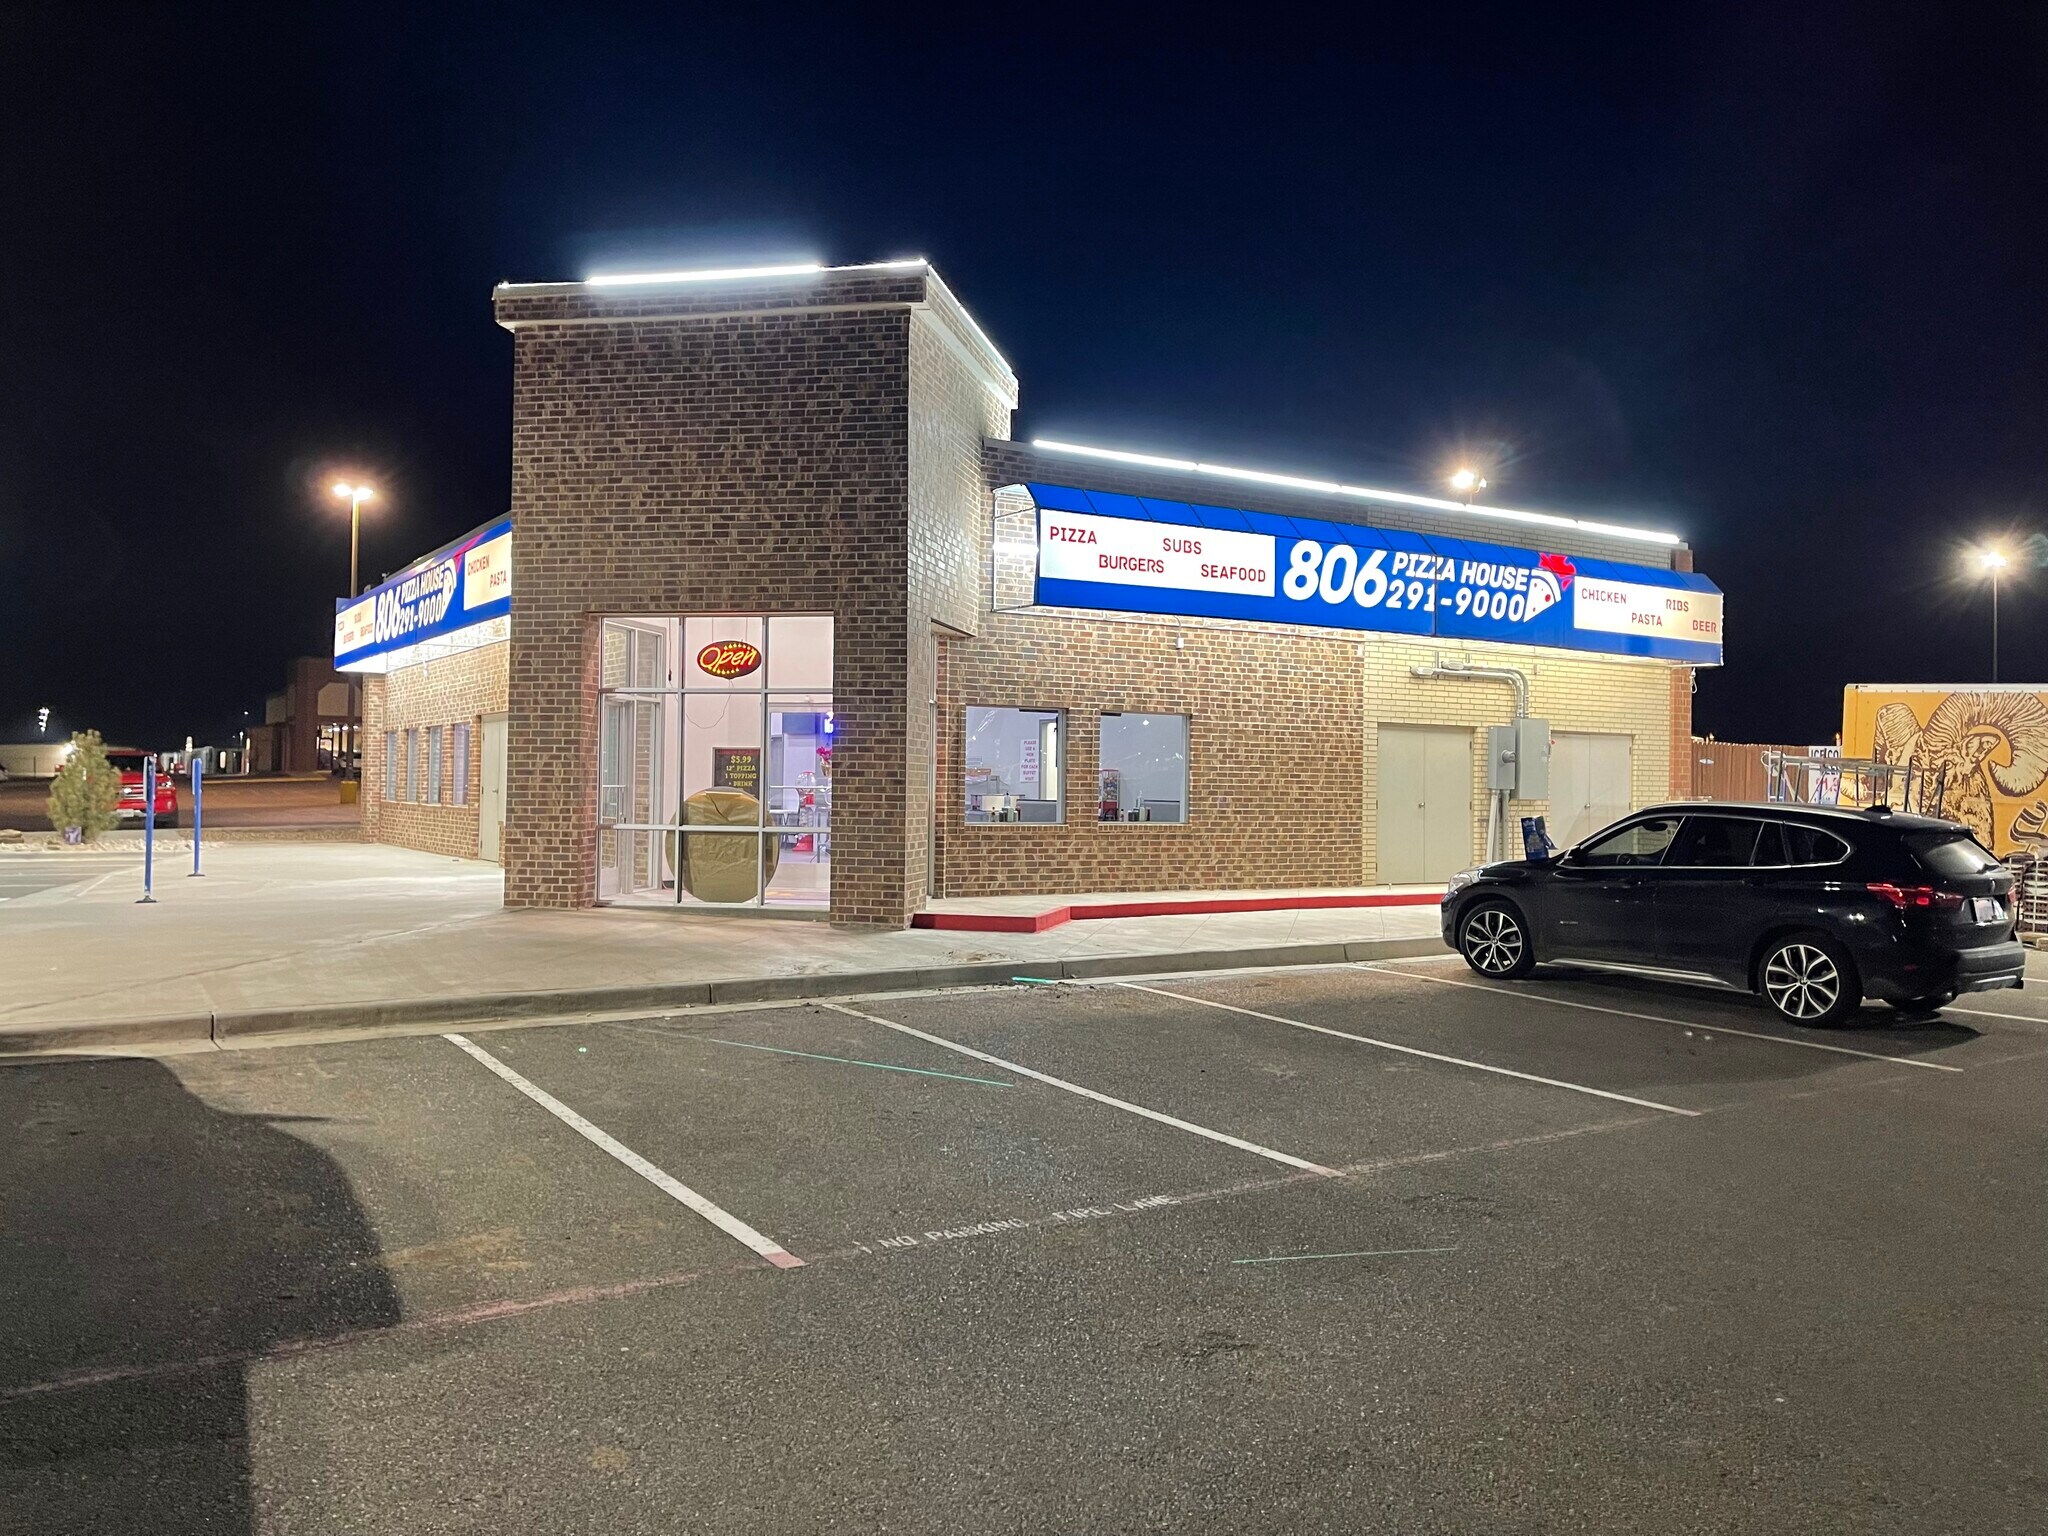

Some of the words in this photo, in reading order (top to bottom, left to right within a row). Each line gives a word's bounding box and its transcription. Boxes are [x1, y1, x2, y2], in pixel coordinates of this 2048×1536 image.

[1050, 526, 1097, 545] PIZZA
[1163, 537, 1202, 555] SUBS
[1098, 554, 1164, 574] BURGERS
[1200, 564, 1266, 582] SEAFOOD
[1283, 539, 1388, 608] 806
[1392, 552, 1455, 582] PIZZA
[1460, 561, 1530, 592] HOUSE
[401, 575, 420, 605] PIZZA
[420, 563, 445, 597] HOUSE
[490, 570, 507, 588] PASTA
[1386, 579, 1525, 622] 291-9000
[1581, 588, 1627, 605] CHICKEN
[1665, 599, 1690, 613] RIBS
[375, 585, 402, 643] 806
[399, 592, 443, 635] 291-9000
[1631, 612, 1663, 627] PASTA
[1692, 620, 1717, 634] BEER
[700, 647, 757, 672] Open
[730, 755, 752, 764] $5.99
[877, 1235, 918, 1248] NO
[924, 1217, 1029, 1241] PARKING
